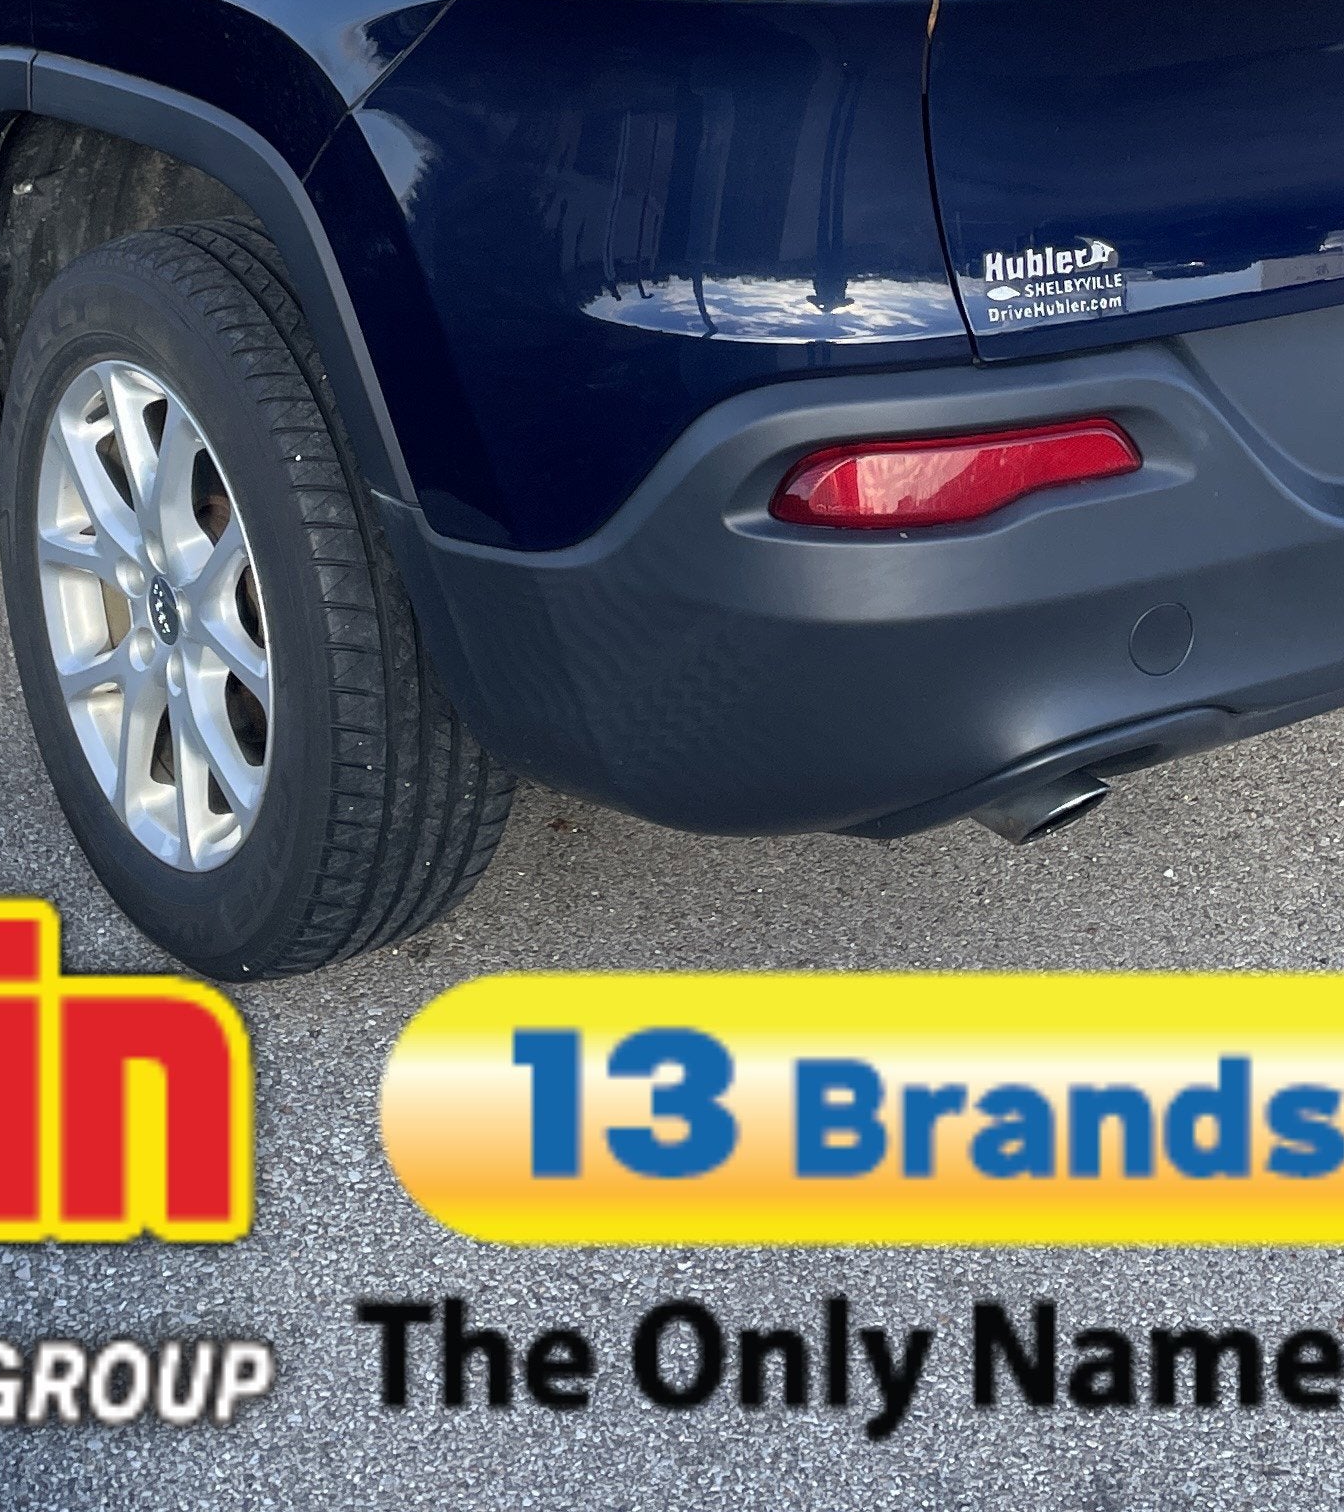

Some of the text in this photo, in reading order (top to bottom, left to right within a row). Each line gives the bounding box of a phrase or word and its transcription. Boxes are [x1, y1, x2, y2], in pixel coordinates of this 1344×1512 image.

[984, 246, 1090, 282] Hubler
[1024, 273, 1123, 298] SHELBYVILLE
[987, 296, 1122, 322] DriveHubler.com
